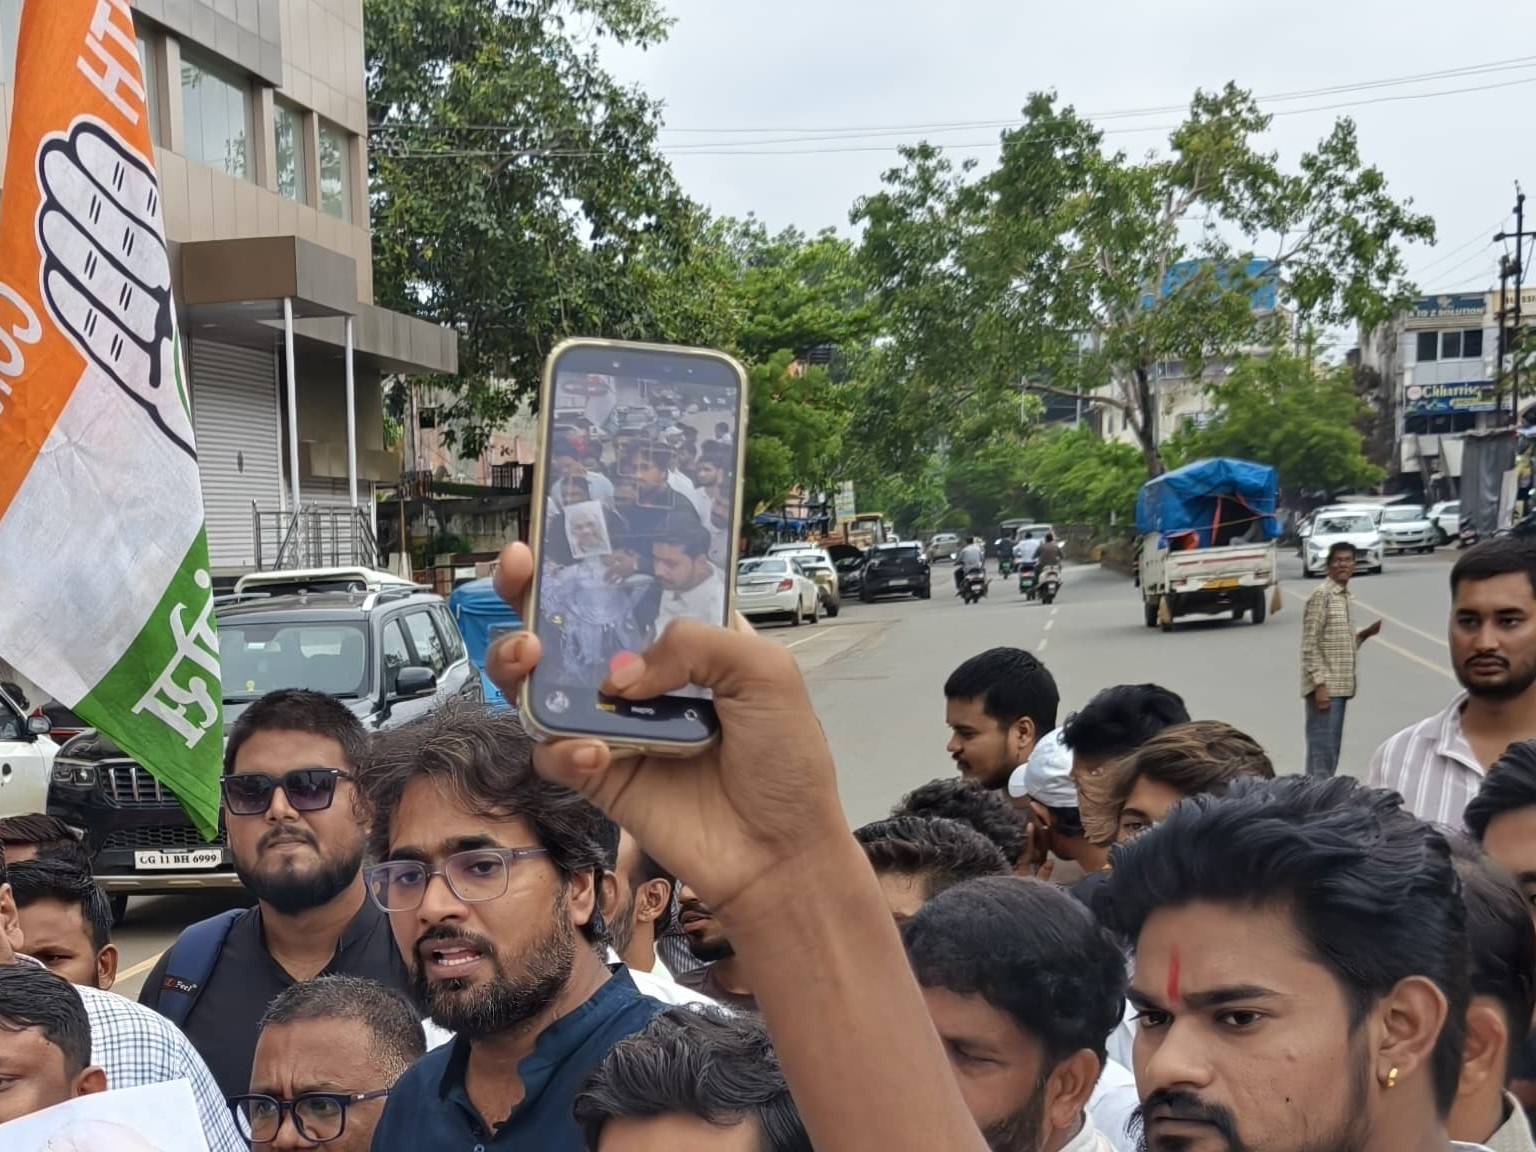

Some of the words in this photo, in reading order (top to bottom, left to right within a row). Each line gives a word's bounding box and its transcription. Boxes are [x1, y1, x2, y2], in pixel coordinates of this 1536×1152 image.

[140, 856, 156, 864] CG
[160, 855, 170, 864] 11
[173, 855, 190, 864] BH
[193, 854, 217, 863] 6999
